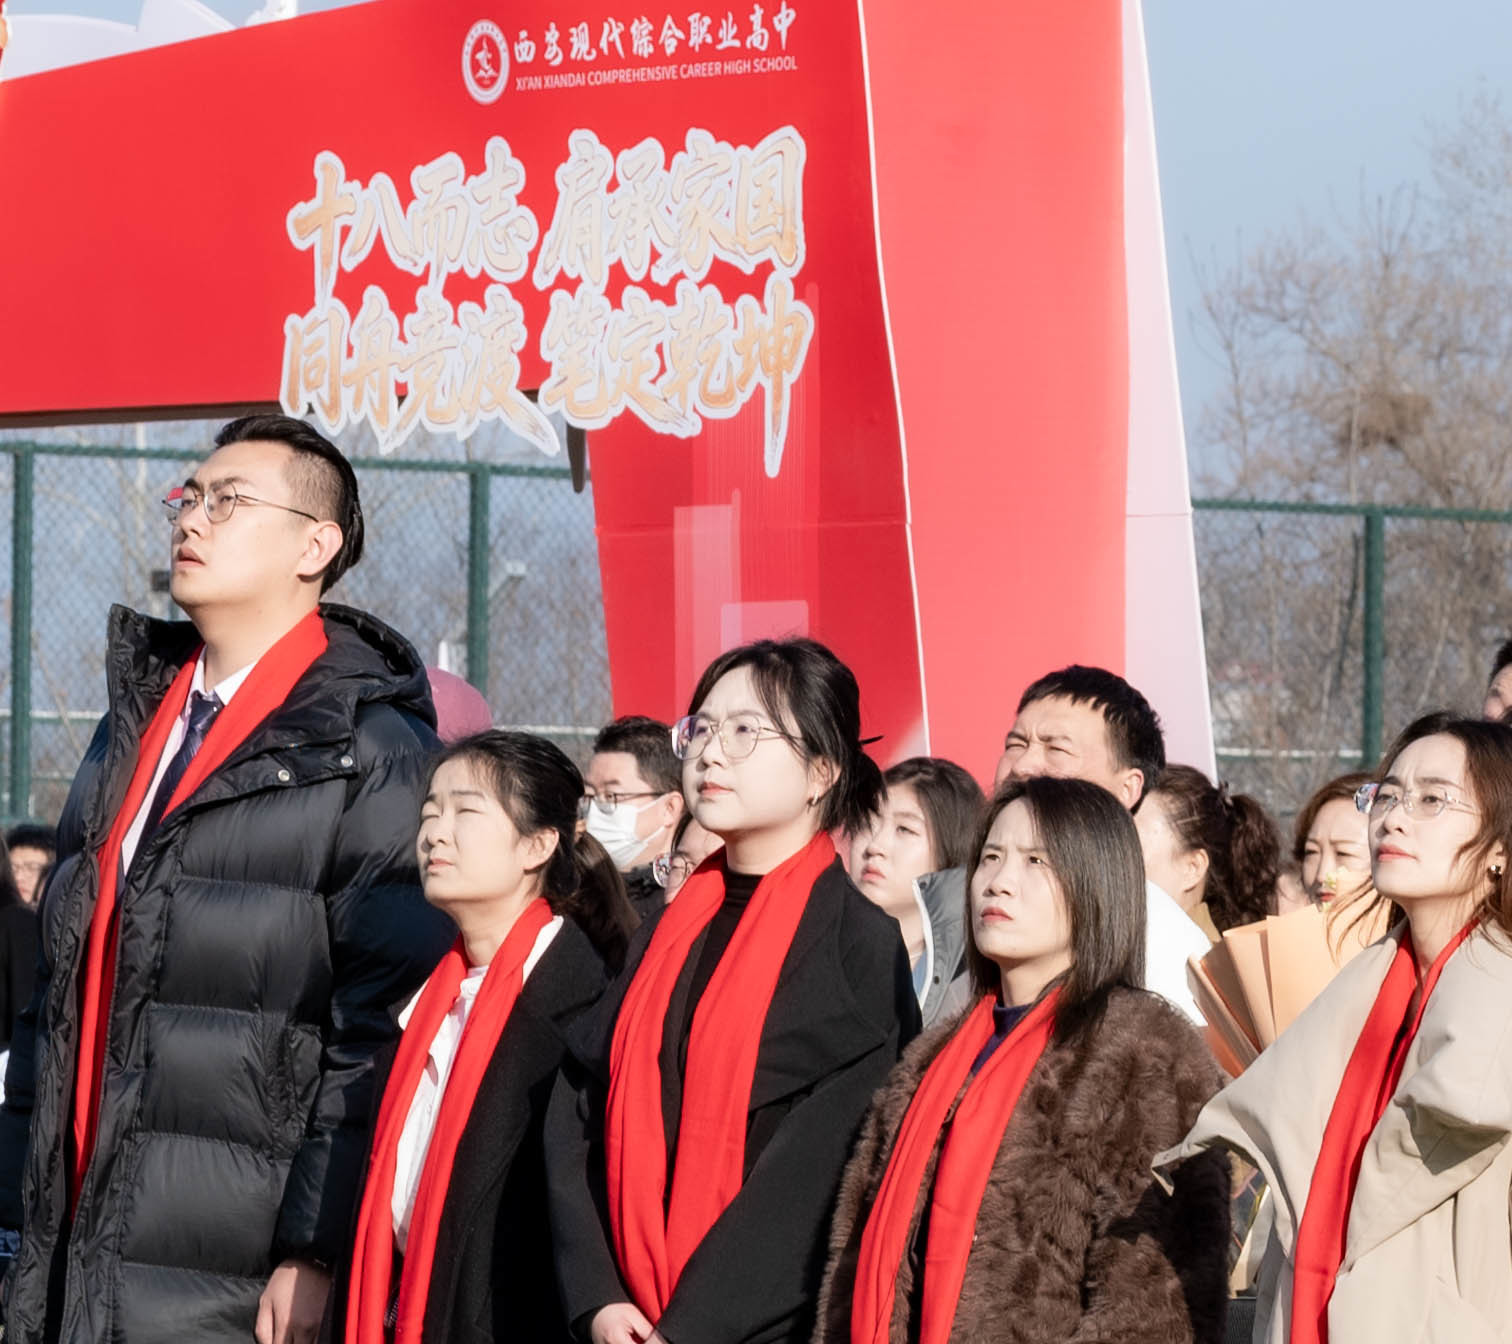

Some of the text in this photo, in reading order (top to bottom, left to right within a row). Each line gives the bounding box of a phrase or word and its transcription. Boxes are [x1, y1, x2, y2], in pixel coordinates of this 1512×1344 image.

[514, 0, 796, 66] 西安现代综合职业高中
[516, 55, 798, 91] XI'AN XIANDAI COMPREHENSIVE CAREER HIGH SCHOOL
[290, 129, 802, 288] 十八而志 肩承家国
[283, 278, 810, 472] 同舟竞渡 笔定乾坤
